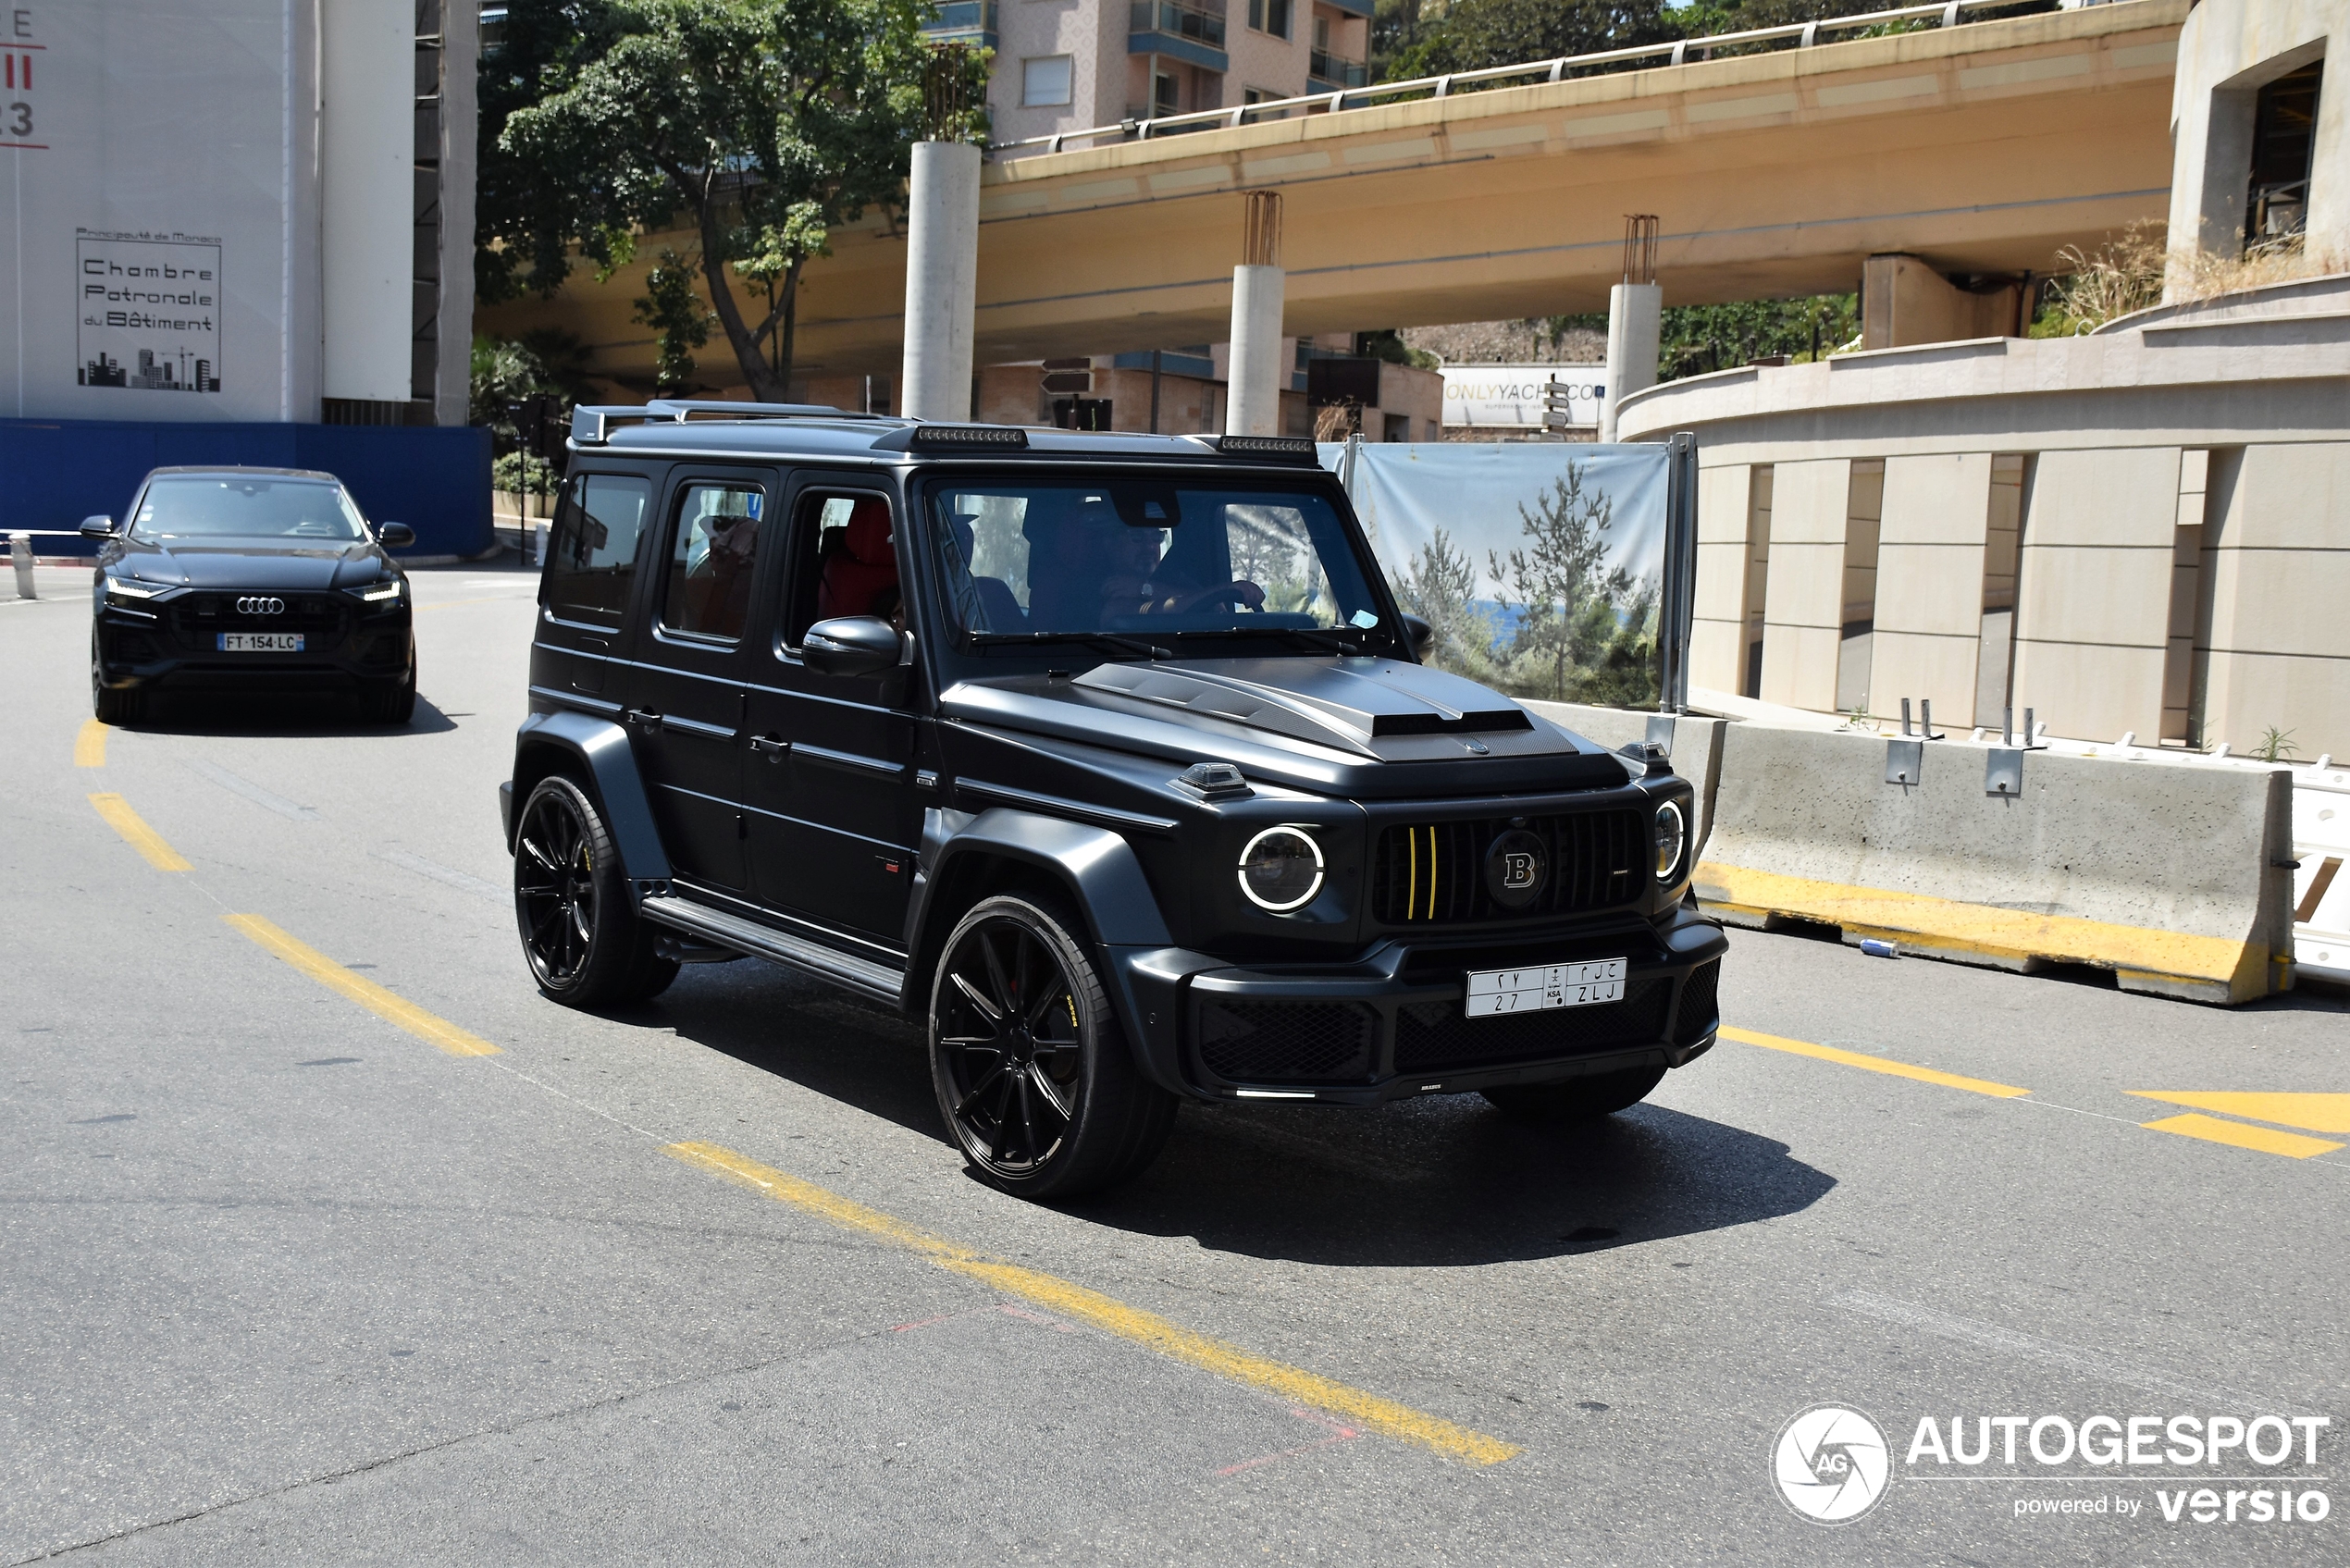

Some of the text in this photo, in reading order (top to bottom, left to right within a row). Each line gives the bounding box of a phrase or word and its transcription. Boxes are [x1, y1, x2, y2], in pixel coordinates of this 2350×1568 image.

[0, 102, 33, 137] 3
[155, 232, 168, 241] de
[172, 232, 222, 243] Monaco
[84, 259, 212, 280] Chambre
[85, 285, 212, 306] Patronale
[84, 312, 212, 331] du Bâtiment
[1504, 853, 1535, 889] B
